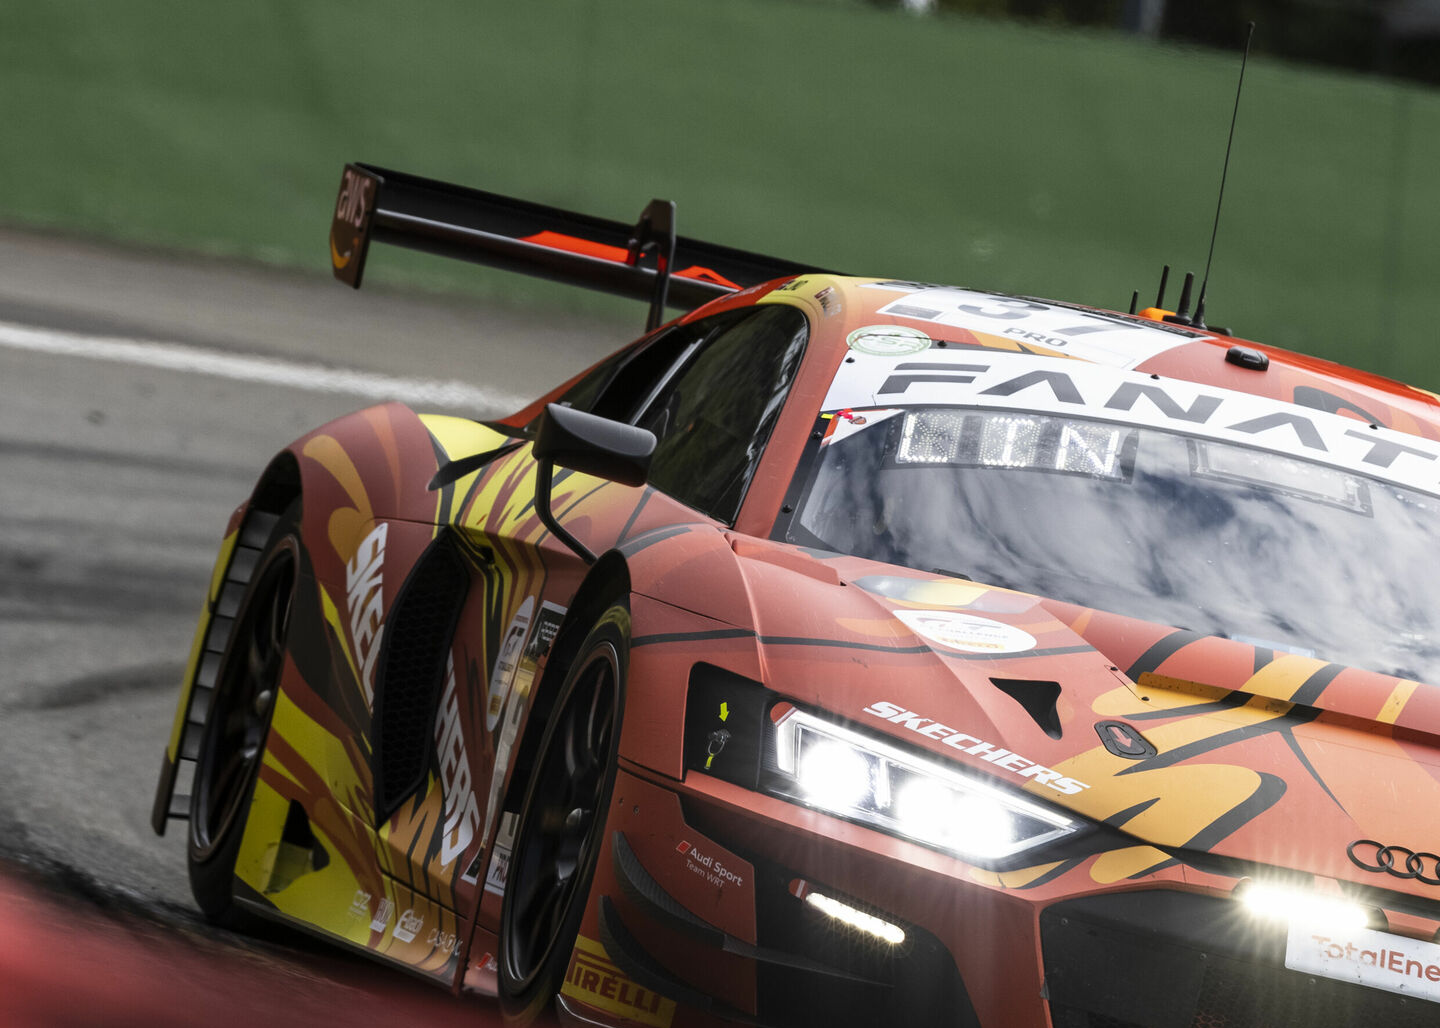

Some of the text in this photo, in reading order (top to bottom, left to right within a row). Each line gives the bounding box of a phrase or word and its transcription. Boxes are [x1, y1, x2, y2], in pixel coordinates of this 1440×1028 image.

[1003, 326, 1069, 348] PRO
[863, 701, 1090, 796] SKECHERS
[686, 859, 725, 888] Team WRT
[690, 848, 743, 886] Audi Sport
[565, 946, 661, 1014] PIRELLI
